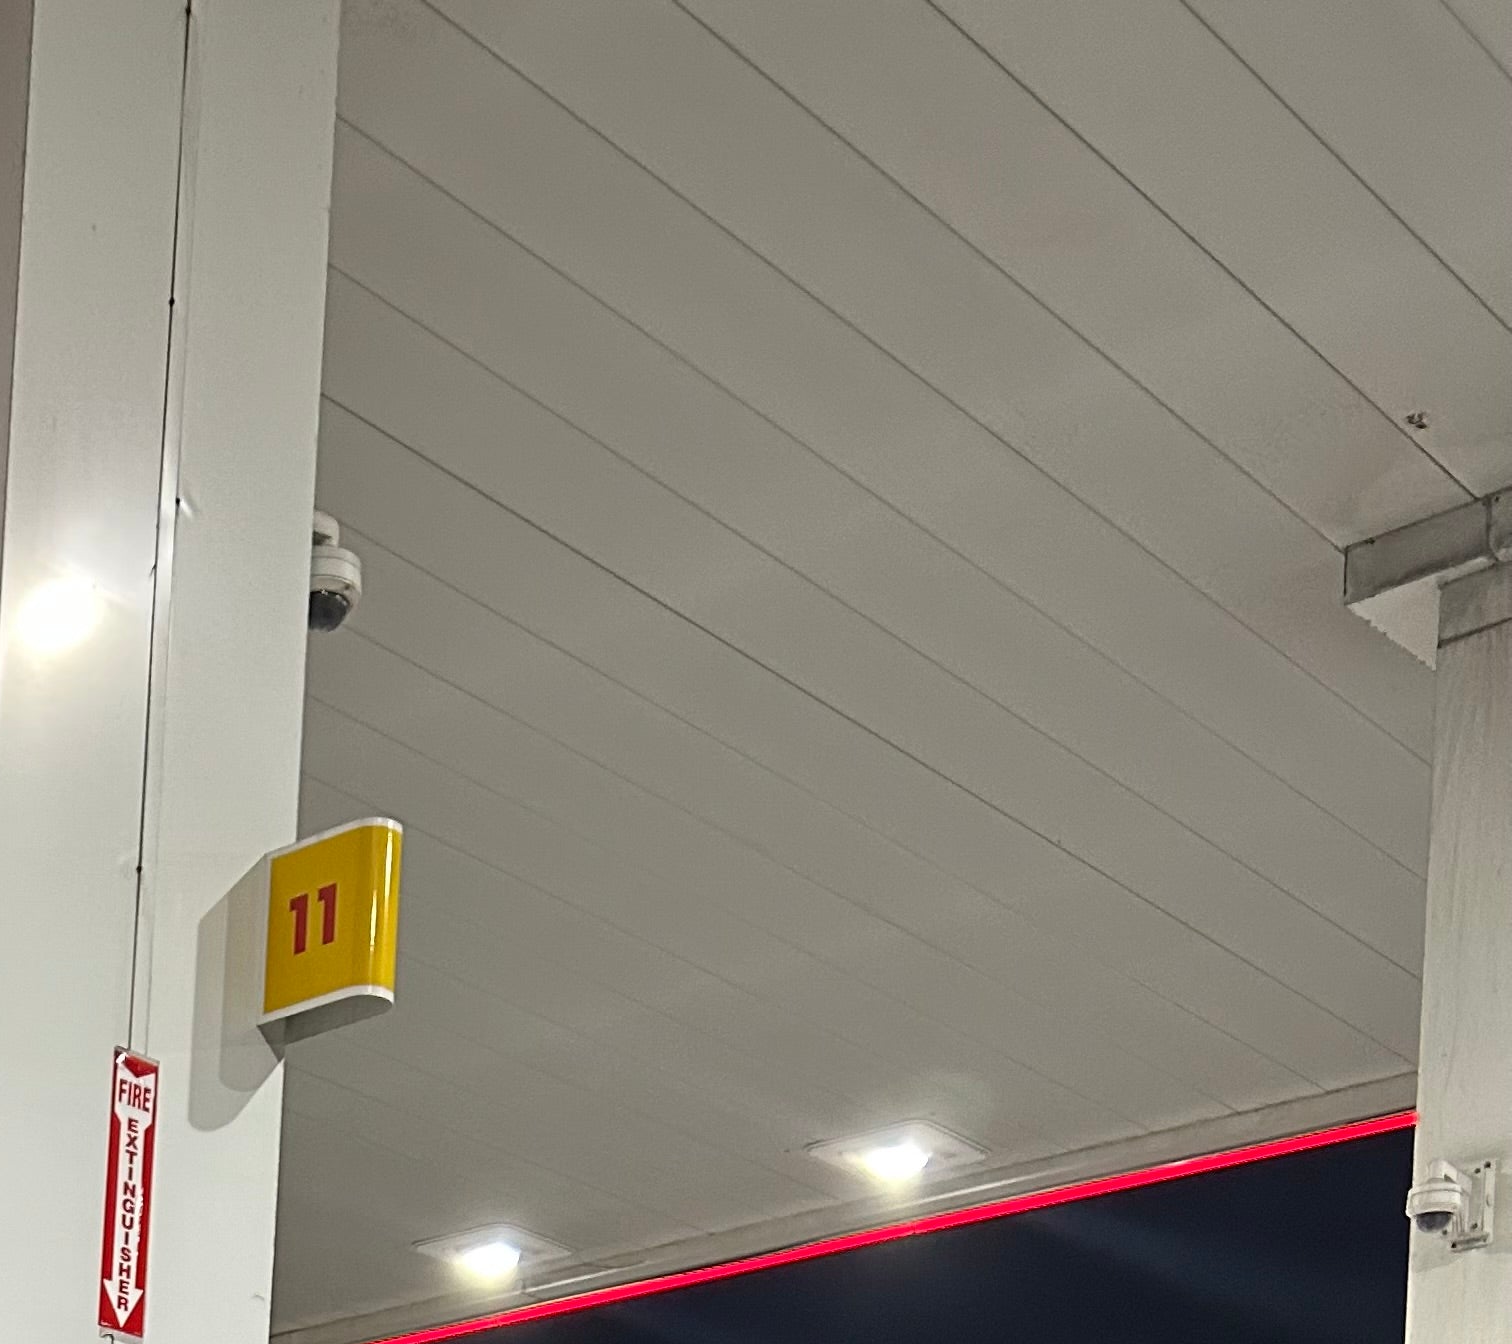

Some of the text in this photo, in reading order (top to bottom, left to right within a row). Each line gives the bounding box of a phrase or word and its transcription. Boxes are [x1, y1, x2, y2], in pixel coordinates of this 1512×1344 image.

[290, 883, 337, 956] 11
[118, 1078, 152, 1113] FIRE
[117, 1118, 139, 1312] EXTINGUISHER
